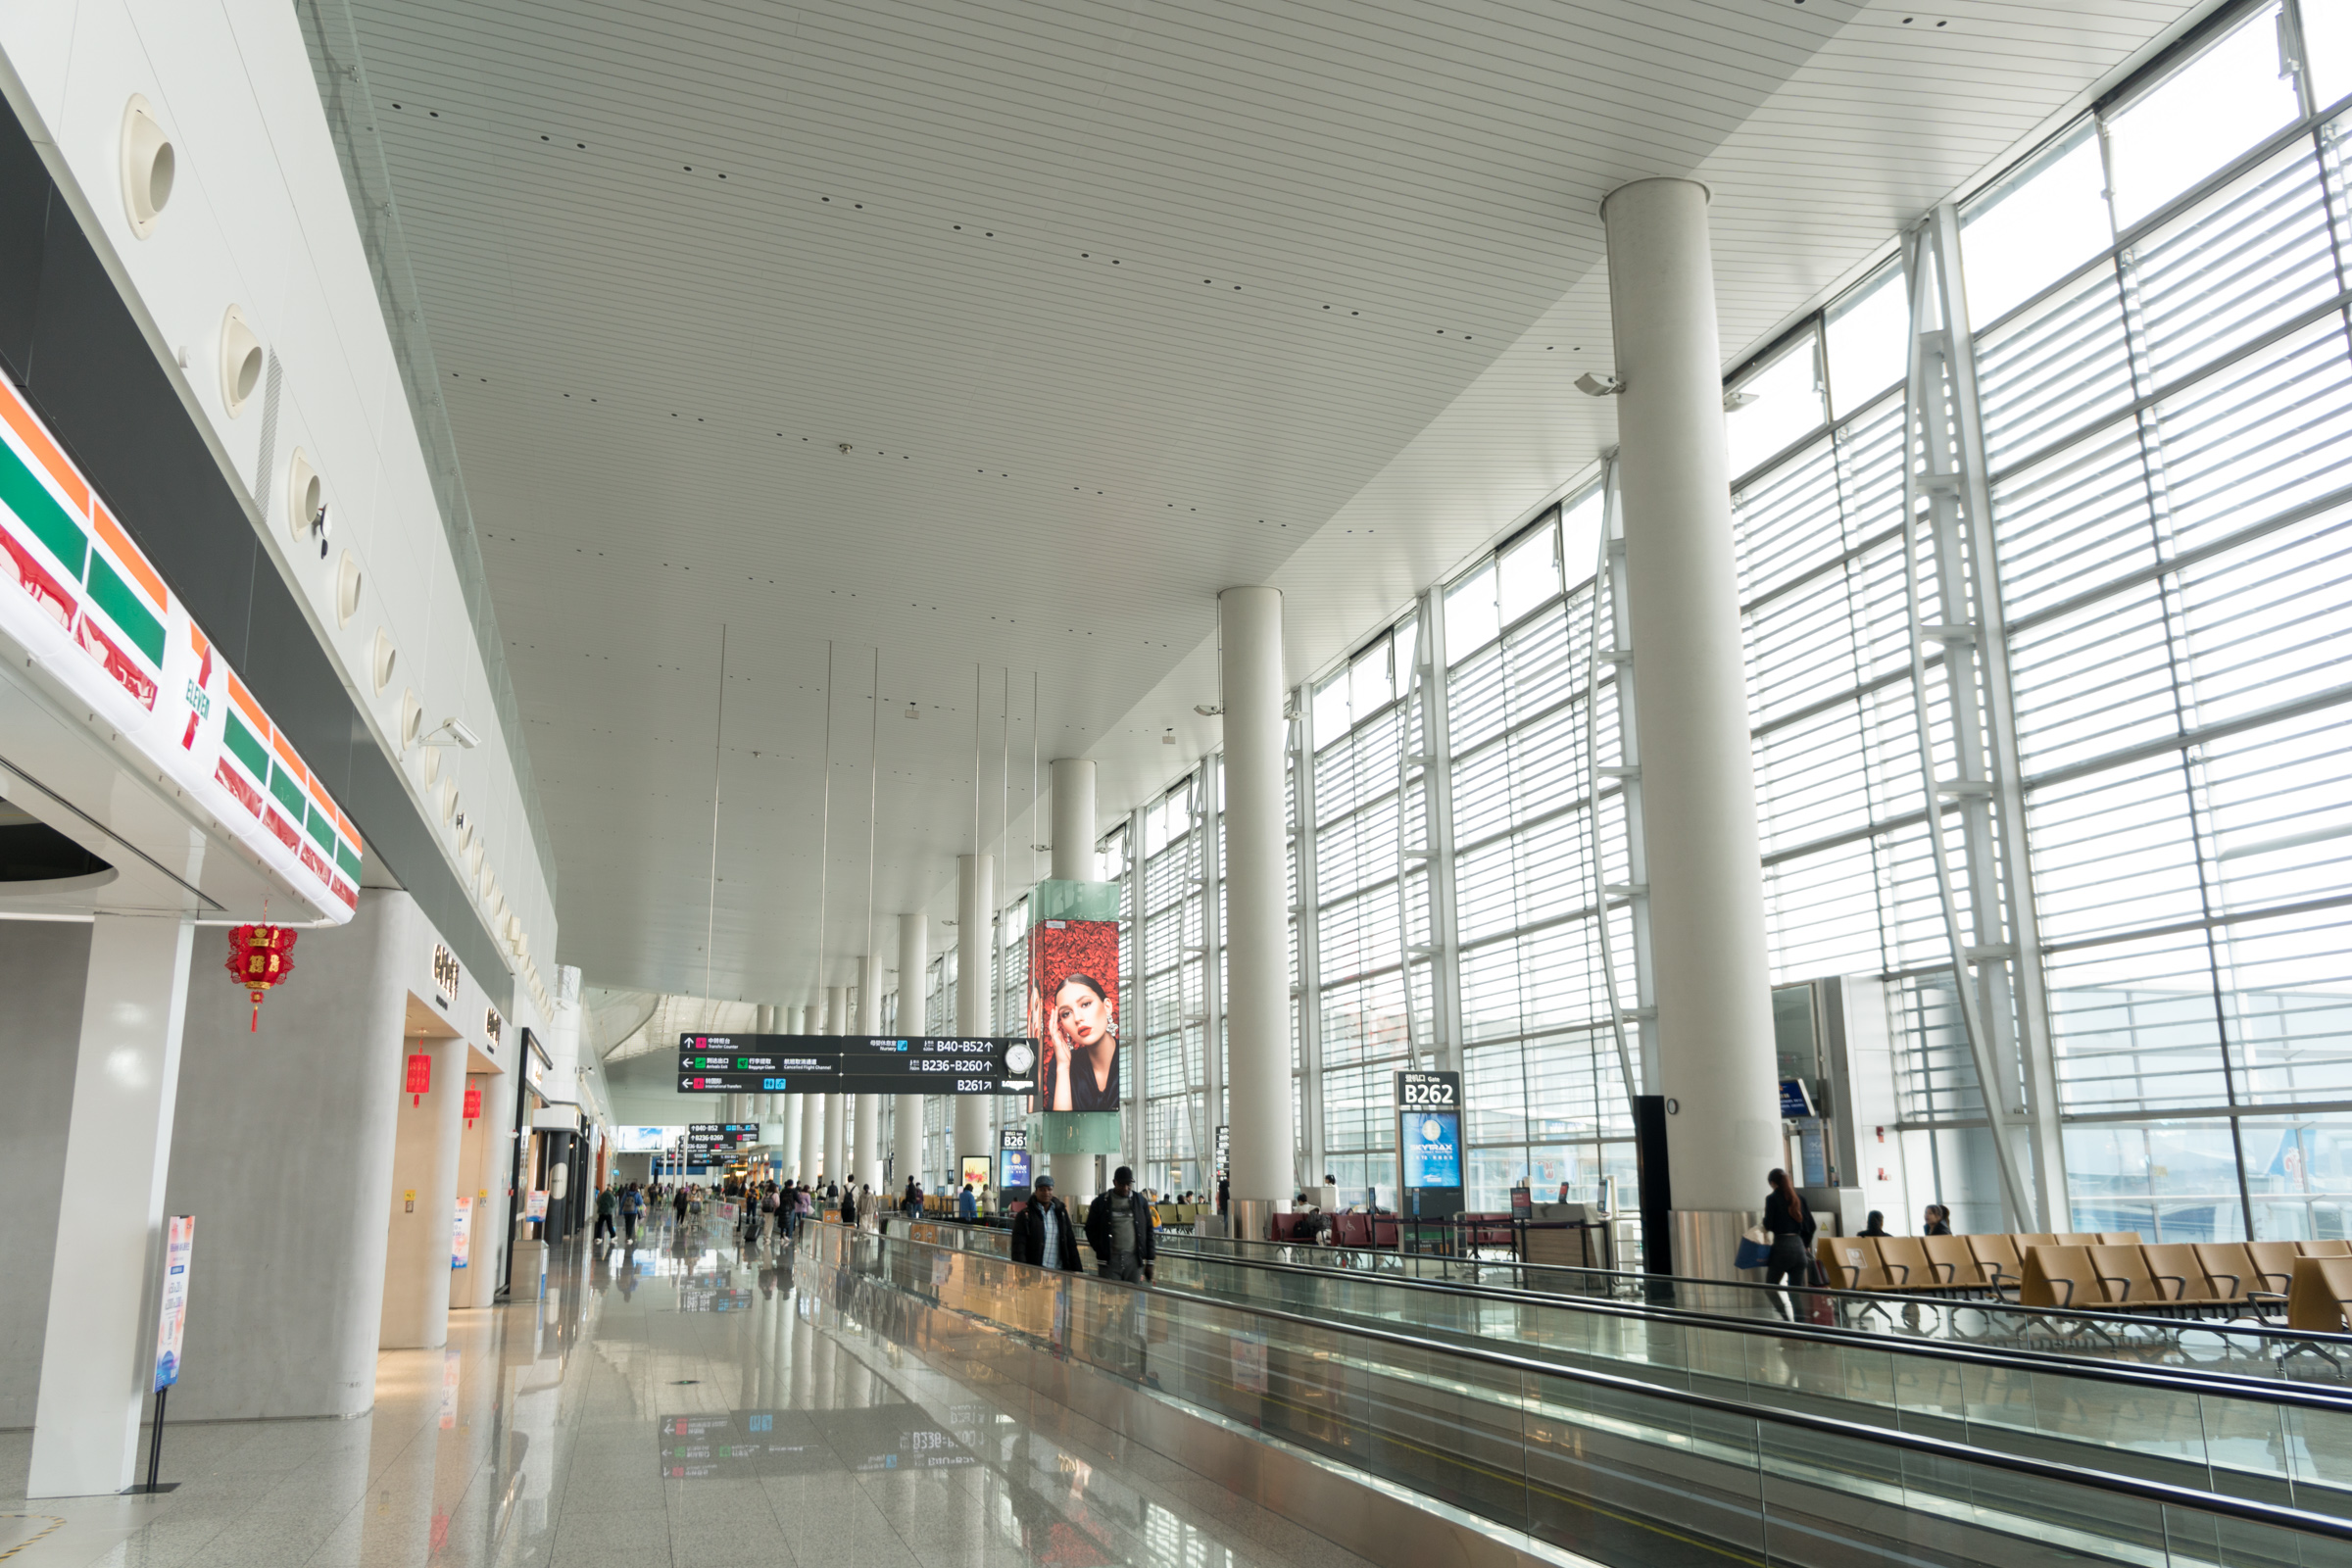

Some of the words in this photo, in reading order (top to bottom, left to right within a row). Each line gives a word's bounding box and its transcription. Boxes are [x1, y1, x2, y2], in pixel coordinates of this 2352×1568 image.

[937, 1041, 984, 1053] B40-B52
[922, 1060, 983, 1072] B236-B260
[957, 1080, 983, 1091] B261
[1404, 1084, 1453, 1103] B262
